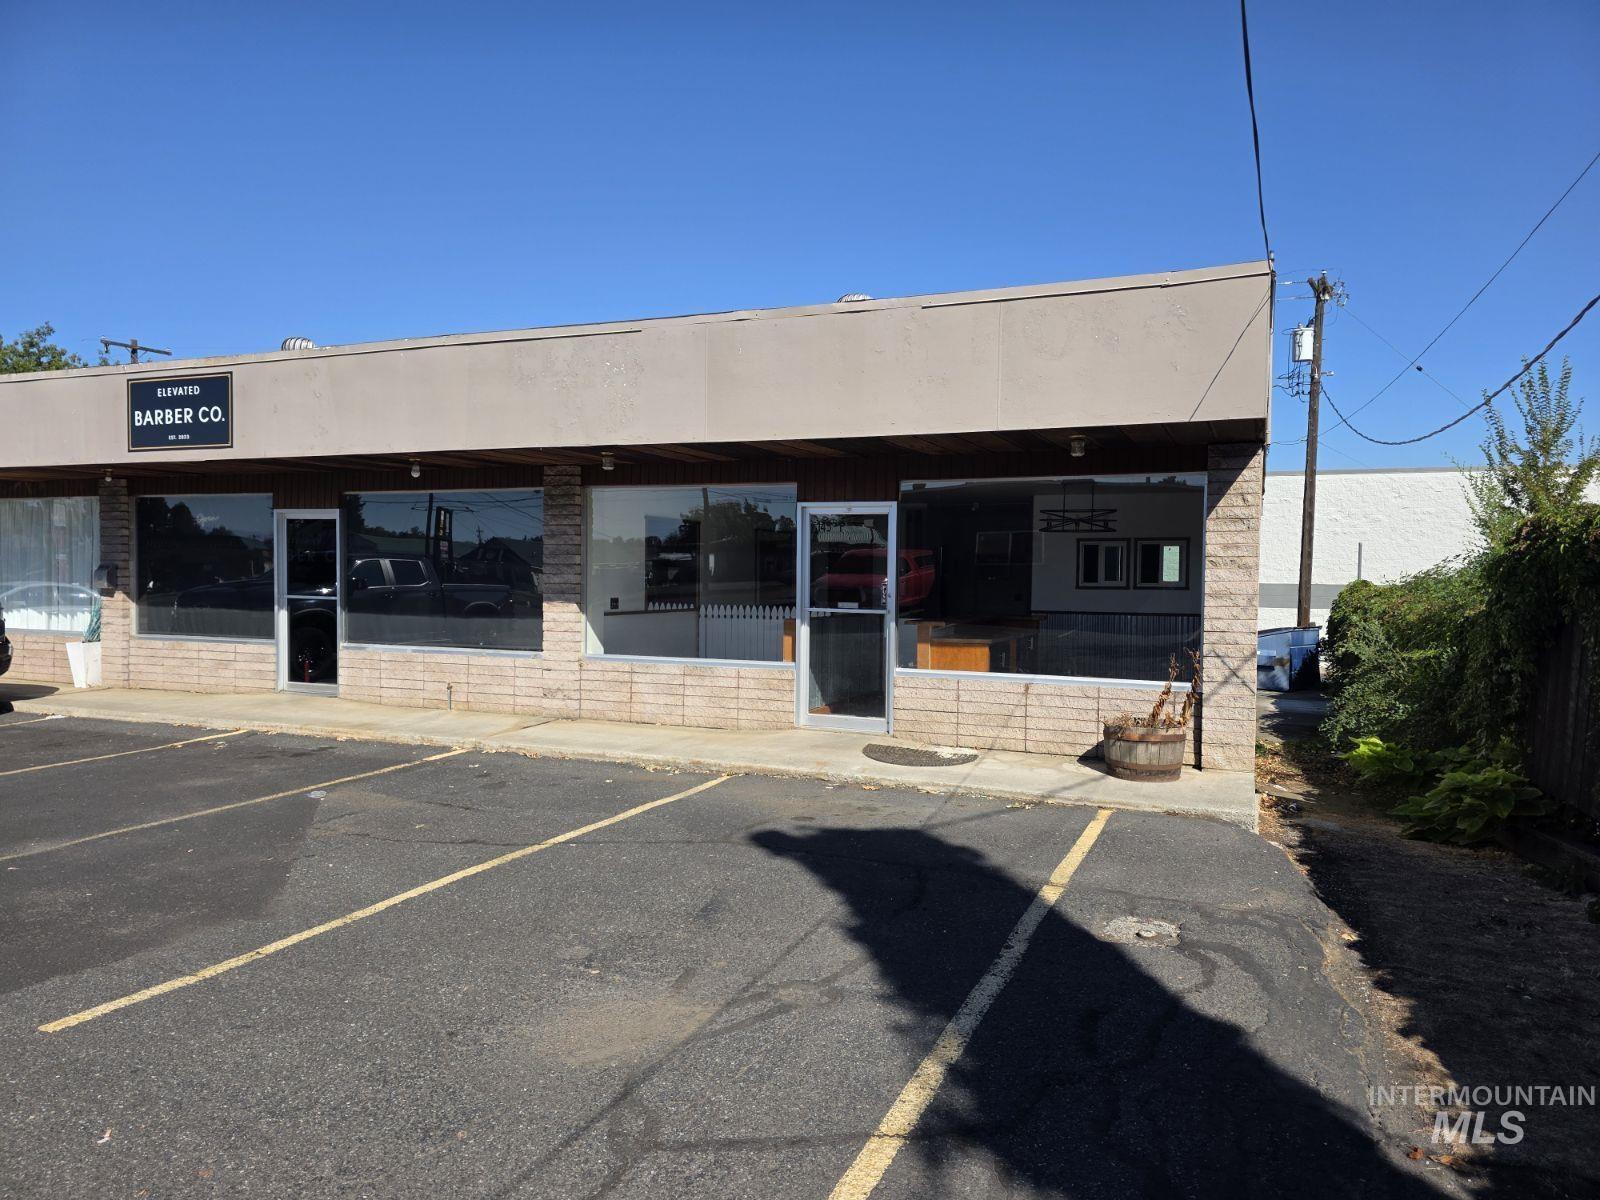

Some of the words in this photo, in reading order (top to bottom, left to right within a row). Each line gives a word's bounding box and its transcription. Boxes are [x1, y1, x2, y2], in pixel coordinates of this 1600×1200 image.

[157, 385, 200, 397] ELEVATED
[134, 407, 193, 426] BARBER
[198, 405, 225, 423] CO.
